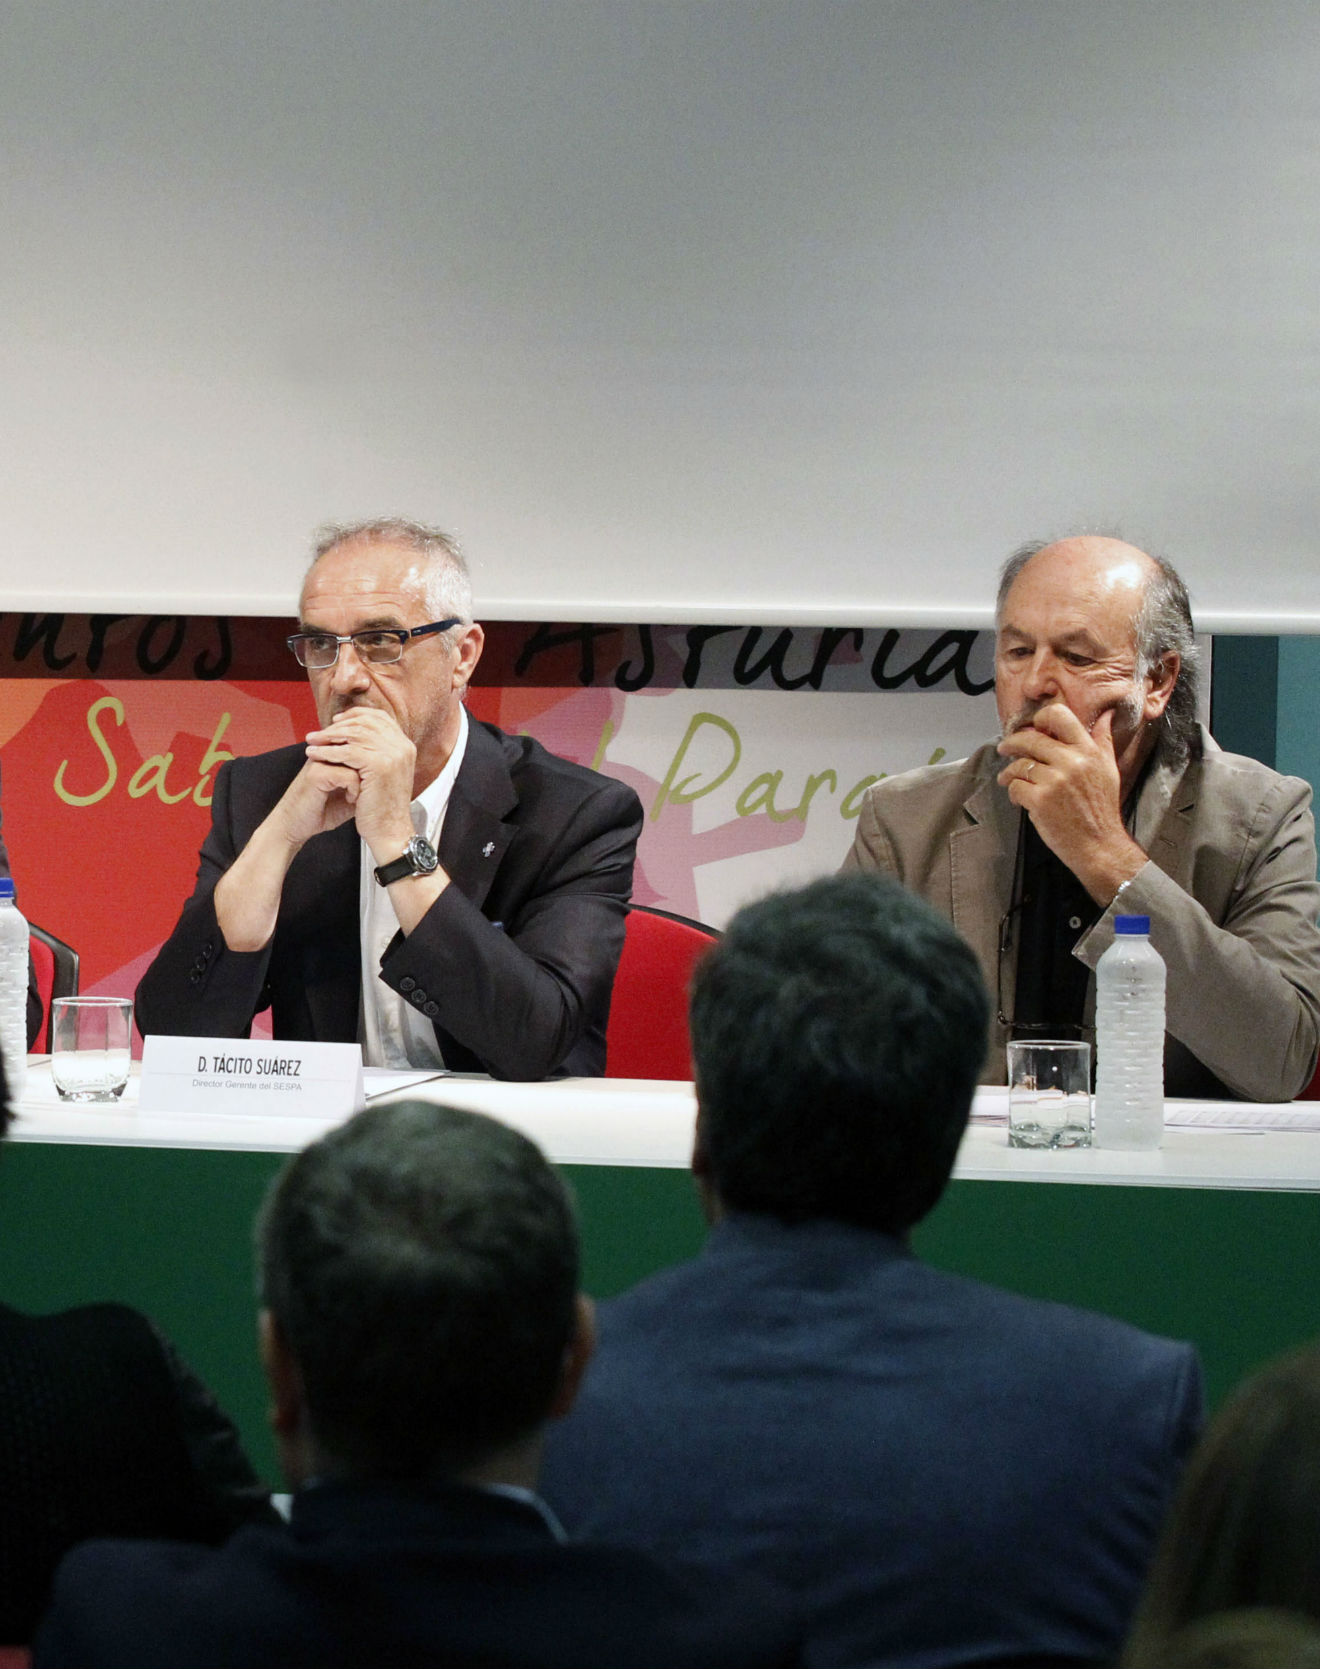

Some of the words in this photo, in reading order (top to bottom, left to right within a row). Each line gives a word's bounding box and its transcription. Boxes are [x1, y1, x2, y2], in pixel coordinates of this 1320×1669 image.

[649, 711, 947, 822] Para
[197, 1056, 208, 1073] D.
[213, 1052, 253, 1075] TÁCITO
[256, 1054, 302, 1077] SUÁREZ
[191, 1078, 223, 1089] Director
[225, 1079, 257, 1090] Gerente
[259, 1081, 271, 1091] del
[273, 1082, 303, 1092] SESPA
